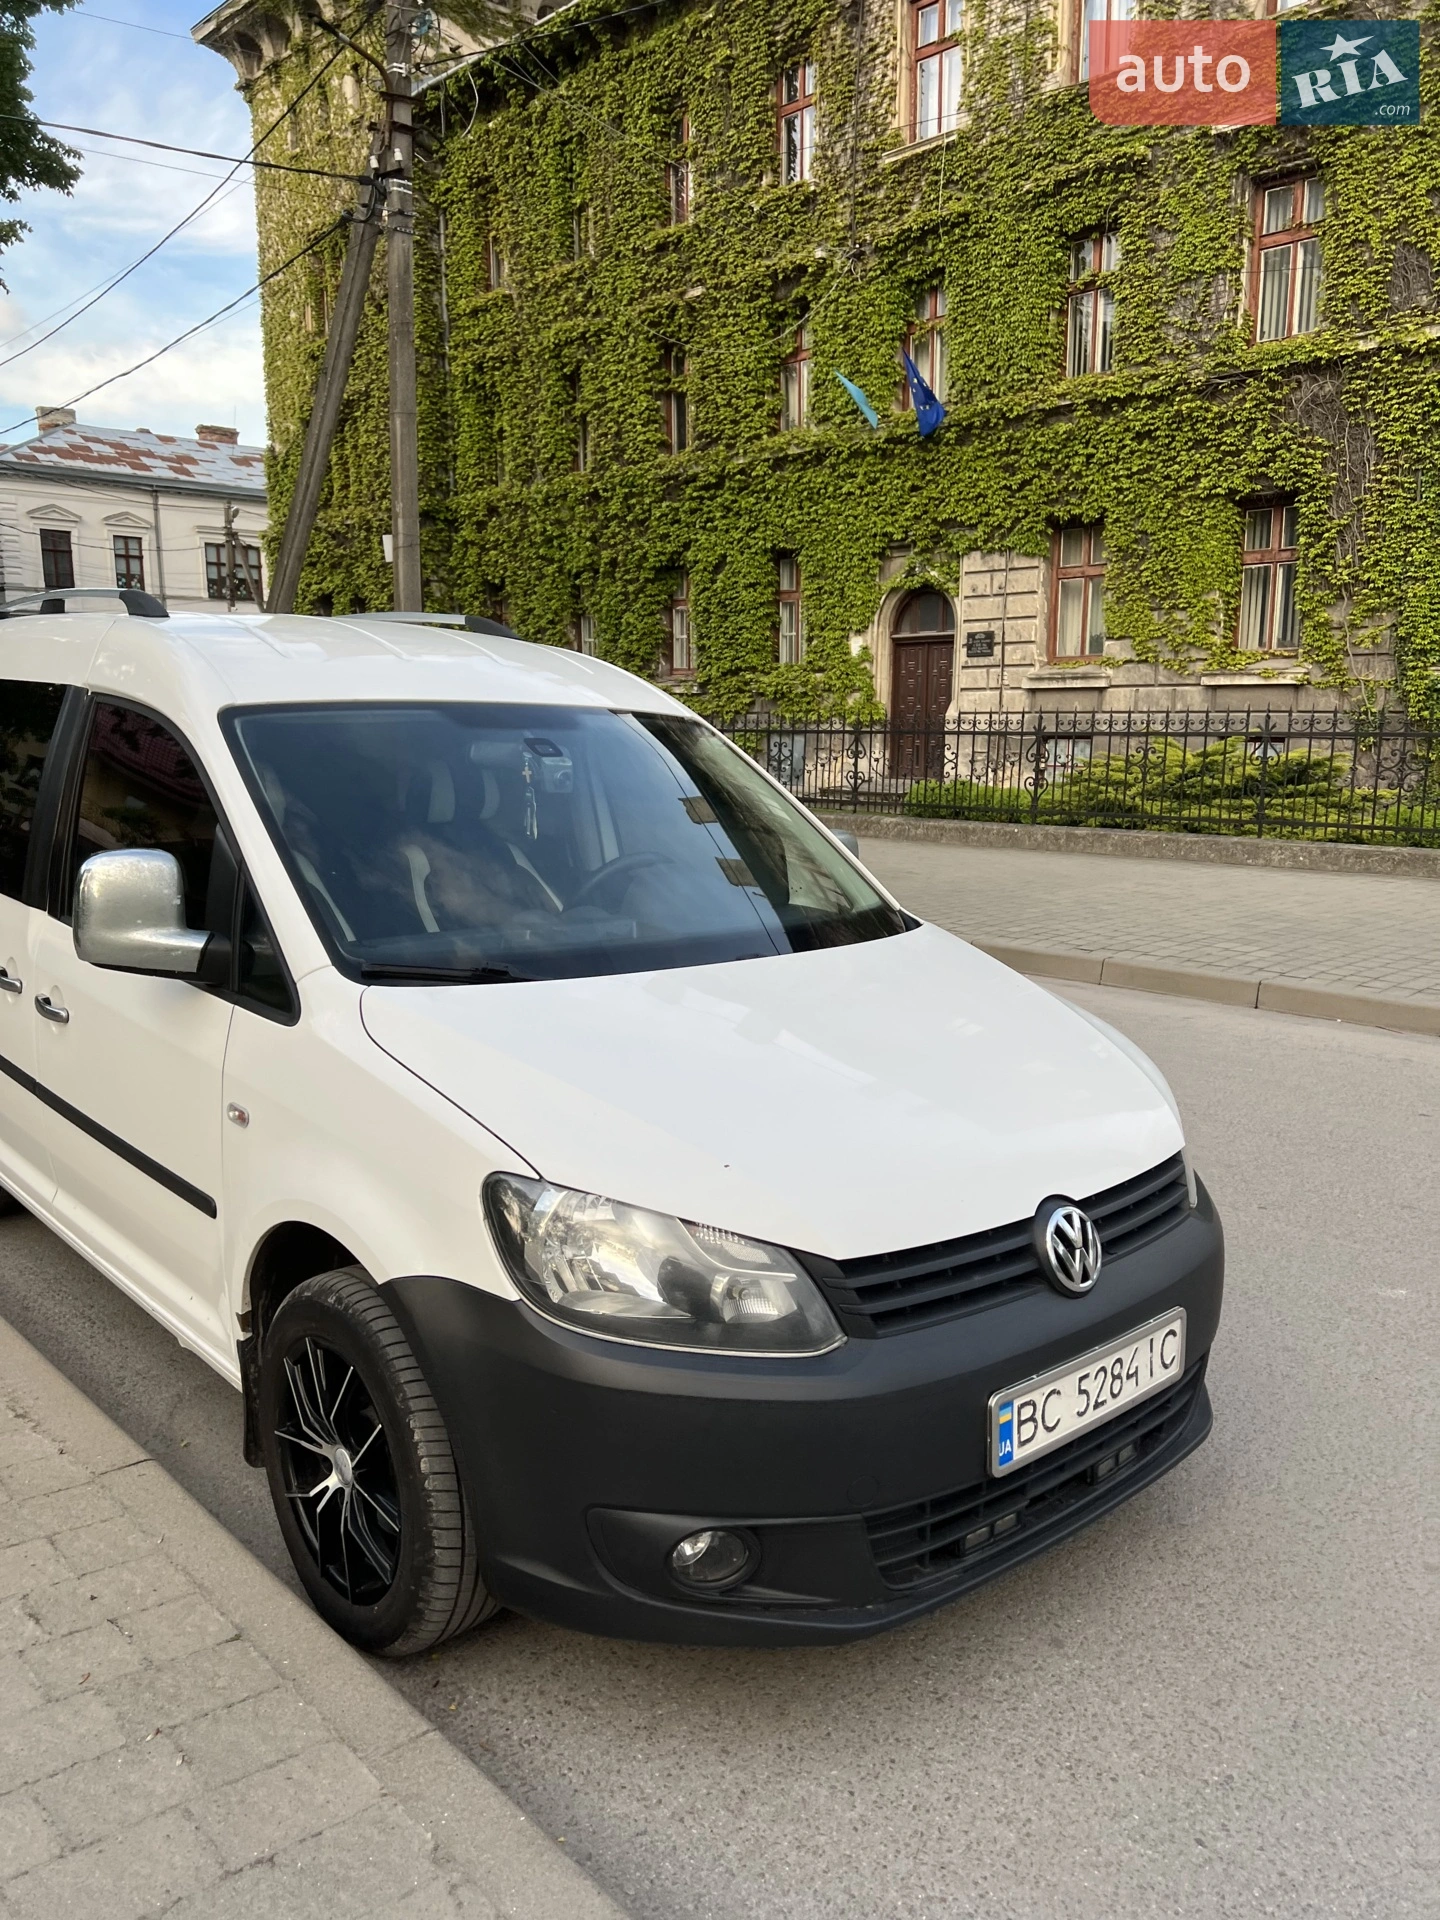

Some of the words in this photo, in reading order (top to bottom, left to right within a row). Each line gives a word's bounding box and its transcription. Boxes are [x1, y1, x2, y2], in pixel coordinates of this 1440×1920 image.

[1016, 1388, 1062, 1449] BC
[1075, 1346, 1140, 1417] 5284
[1149, 1328, 1178, 1378] IC
[999, 1438, 1012, 1457] UA
